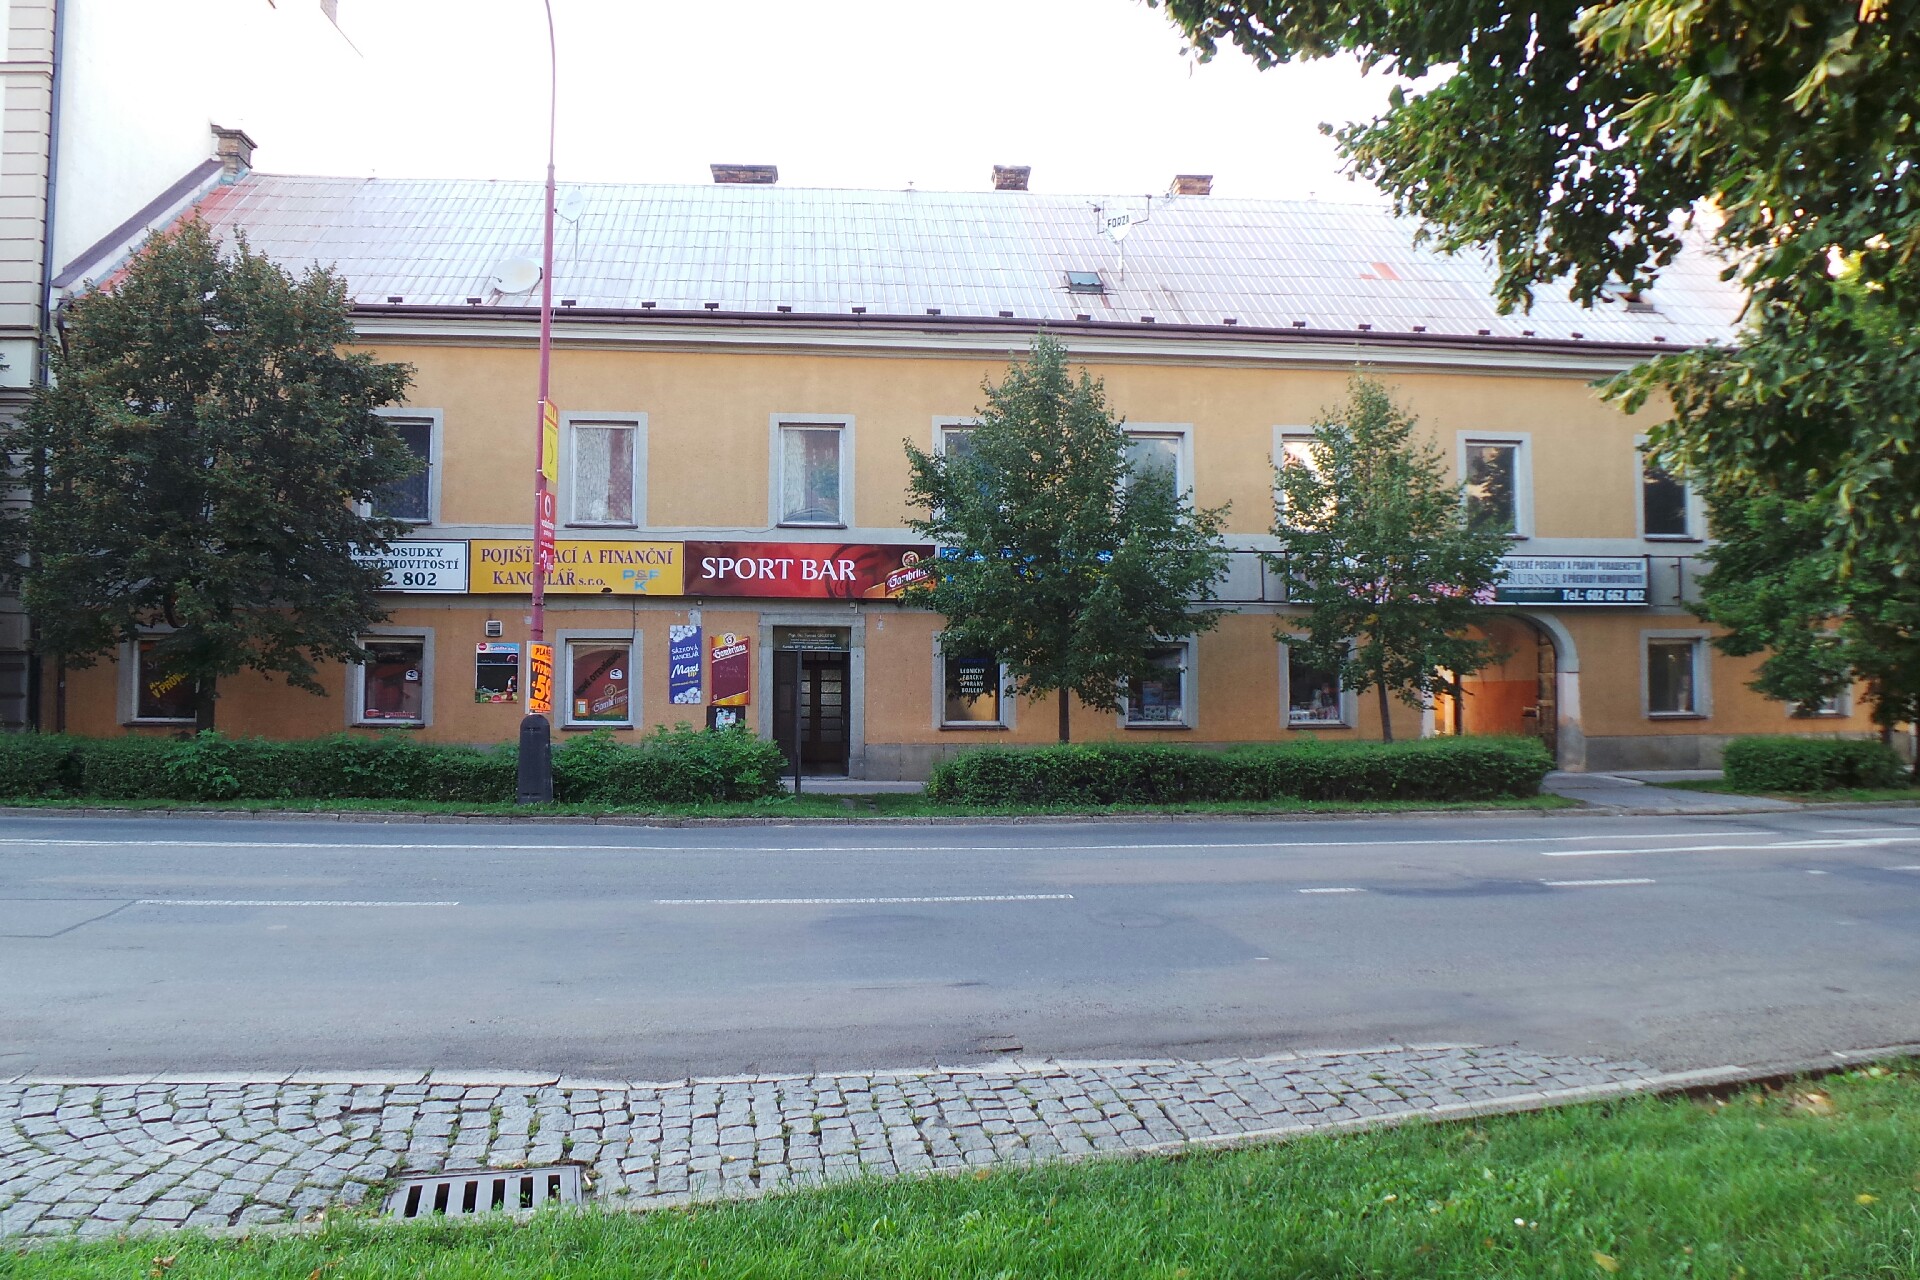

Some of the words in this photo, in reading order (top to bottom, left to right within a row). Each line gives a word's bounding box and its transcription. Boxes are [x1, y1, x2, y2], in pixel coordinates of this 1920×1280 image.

[1107, 215, 1130, 228] FORZA
[385, 547, 444, 557] OSUDKY
[481, 546, 578, 565] POJIŠŤACÍ
[583, 550, 593, 564] A
[599, 547, 674, 565] FINANČNÍ
[702, 557, 793, 580] SPORT
[801, 559, 857, 581] BAR
[402, 571, 437, 586] 802
[493, 568, 576, 586] KANCLÁŘ
[578, 576, 606, 586] s.r.o.
[886, 567, 931, 588] Gambri
[671, 643, 699, 655] SÁZKOVÁ
[712, 644, 746, 659] Gambrinus
